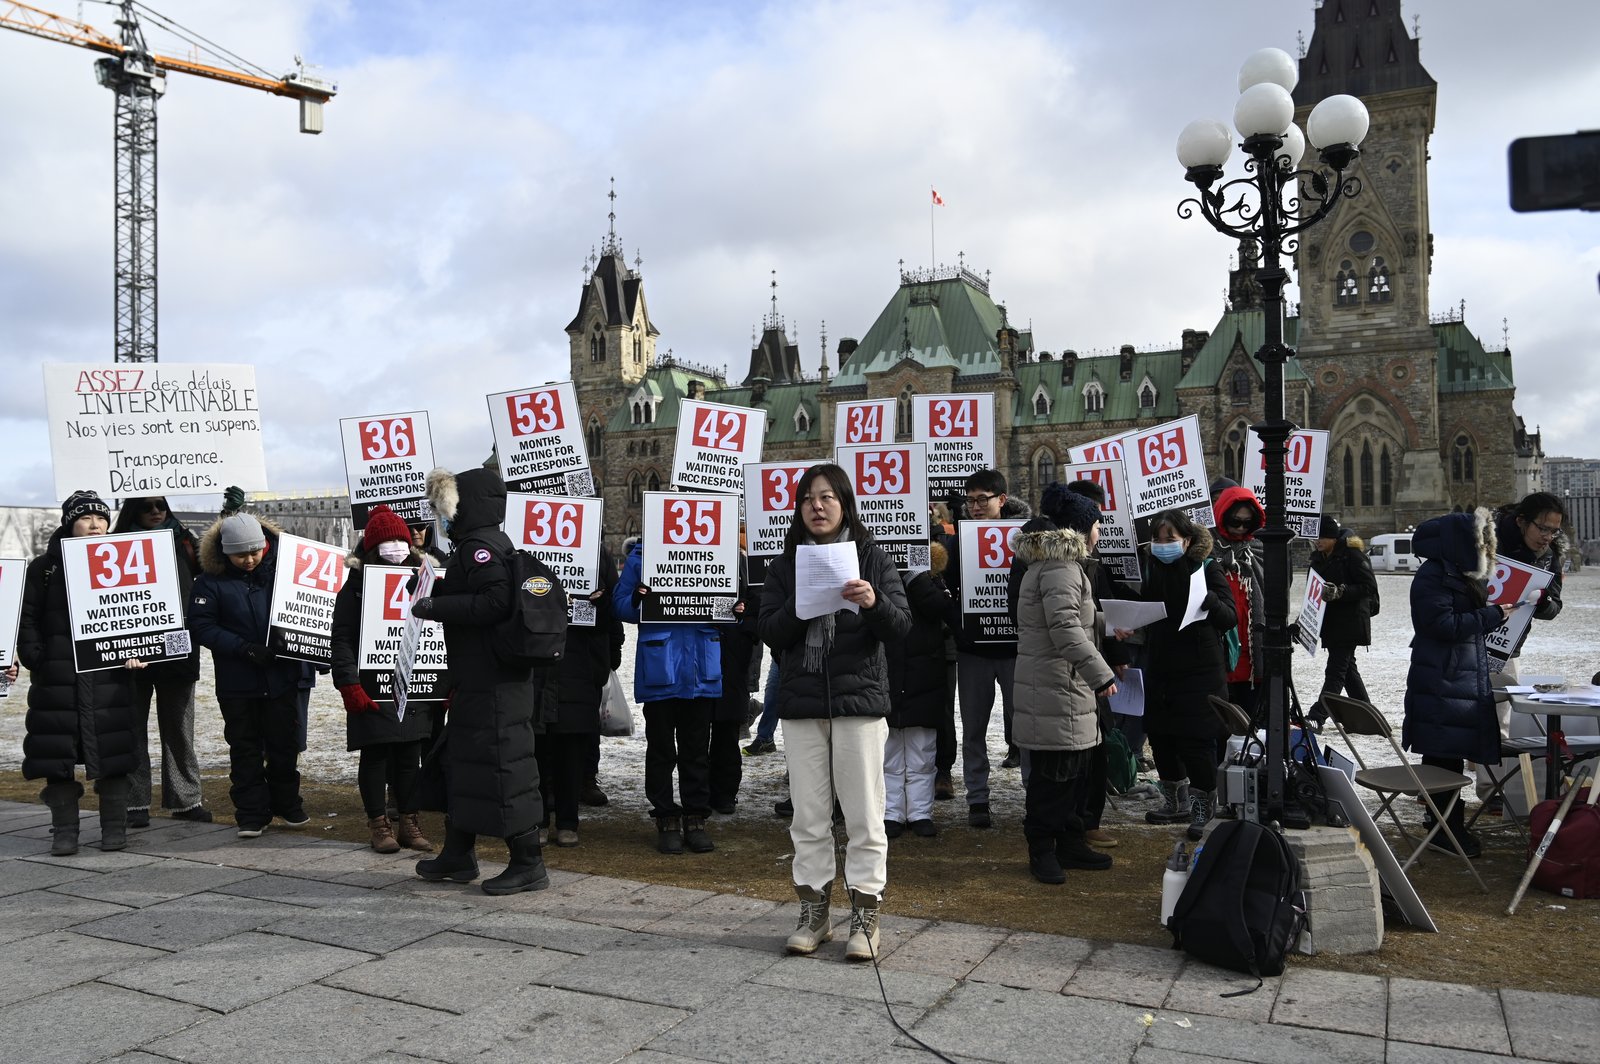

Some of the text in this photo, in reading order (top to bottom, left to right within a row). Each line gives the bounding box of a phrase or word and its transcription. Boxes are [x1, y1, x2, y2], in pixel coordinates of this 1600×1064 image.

[75, 370, 231, 393] ASSEZ des délais
[77, 389, 259, 415] INTERMINABLE
[514, 391, 558, 434] 53
[933, 400, 974, 437] 34
[66, 419, 260, 438] Nos vies sont en suspens.
[698, 410, 741, 451] 42
[849, 406, 879, 443] 34
[365, 419, 411, 459] 36
[519, 435, 562, 451] MONTHS
[934, 442, 973, 451] MONTHS
[510, 445, 575, 464] WAITING FOR
[697, 451, 738, 466] MONTHS
[965, 453, 984, 461] FOR
[1144, 428, 1182, 473] 65
[1288, 436, 1307, 472] 0
[109, 450, 223, 469] Transparence.
[507, 456, 583, 477] IRCC RESPONSE
[369, 461, 412, 475] MONTHS
[686, 462, 726, 476] WAITING
[862, 451, 904, 495] 53
[109, 468, 218, 493] Délais clairs.
[360, 471, 425, 487] WAITING FOR
[520, 475, 566, 491] NO TIMELIN
[678, 472, 744, 490] IRCC RESPONS
[928, 480, 967, 488] NO TIMELI
[1147, 470, 1184, 488] MONTHS
[1286, 476, 1303, 486] THS
[355, 483, 426, 500] IRCC RESPONS
[931, 489, 943, 497] NO
[1139, 478, 1196, 501] WAITING FOR
[1294, 488, 1312, 498] FOR
[387, 500, 422, 511] MELINE
[860, 499, 904, 511] MONTHS
[1136, 488, 1204, 513] IRCC RESPONSE
[1286, 499, 1316, 509] PONSE
[395, 509, 421, 519] SULTS
[769, 515, 794, 525] MON
[858, 511, 916, 524] AITING FOR
[529, 502, 578, 547] 36
[668, 500, 715, 545] 35
[758, 528, 789, 538] WAITI
[1110, 527, 1124, 536] FOR
[753, 541, 776, 551] IRCC
[95, 540, 150, 587] 34
[668, 551, 714, 561] MONTHS
[298, 547, 338, 592] 24
[563, 566, 585, 577] FOR
[656, 564, 726, 574] WAITING FOR
[525, 581, 552, 589] Dickies
[649, 577, 732, 588] IRCC RESPONSE
[985, 574, 1010, 584] MON
[1487, 563, 1512, 601] 8
[99, 590, 152, 605] MONTHS
[296, 591, 335, 607] MONTHS
[389, 575, 411, 620] 4
[975, 586, 1008, 596] WAITIN
[660, 596, 714, 605] NO TIMELINE
[969, 599, 992, 608] IRCC
[87, 601, 167, 621] WAITING FOR
[285, 601, 324, 618] WAITING
[663, 607, 676, 616] NO
[81, 613, 175, 634] IRCC RESPONSE
[277, 612, 332, 632] IRCC RESPO
[980, 617, 992, 625] NO
[983, 627, 995, 635] NO
[1494, 626, 1509, 635] OR
[95, 634, 165, 652] NO TIMELINES
[285, 632, 332, 648] NO TIMELINE
[424, 640, 444, 651] FOR
[101, 645, 162, 662] NO RESULTS
[286, 643, 332, 659] NO RESULTS
[367, 653, 391, 664] IRCC
[377, 673, 390, 683] NO
[407, 684, 433, 693] SULTS
